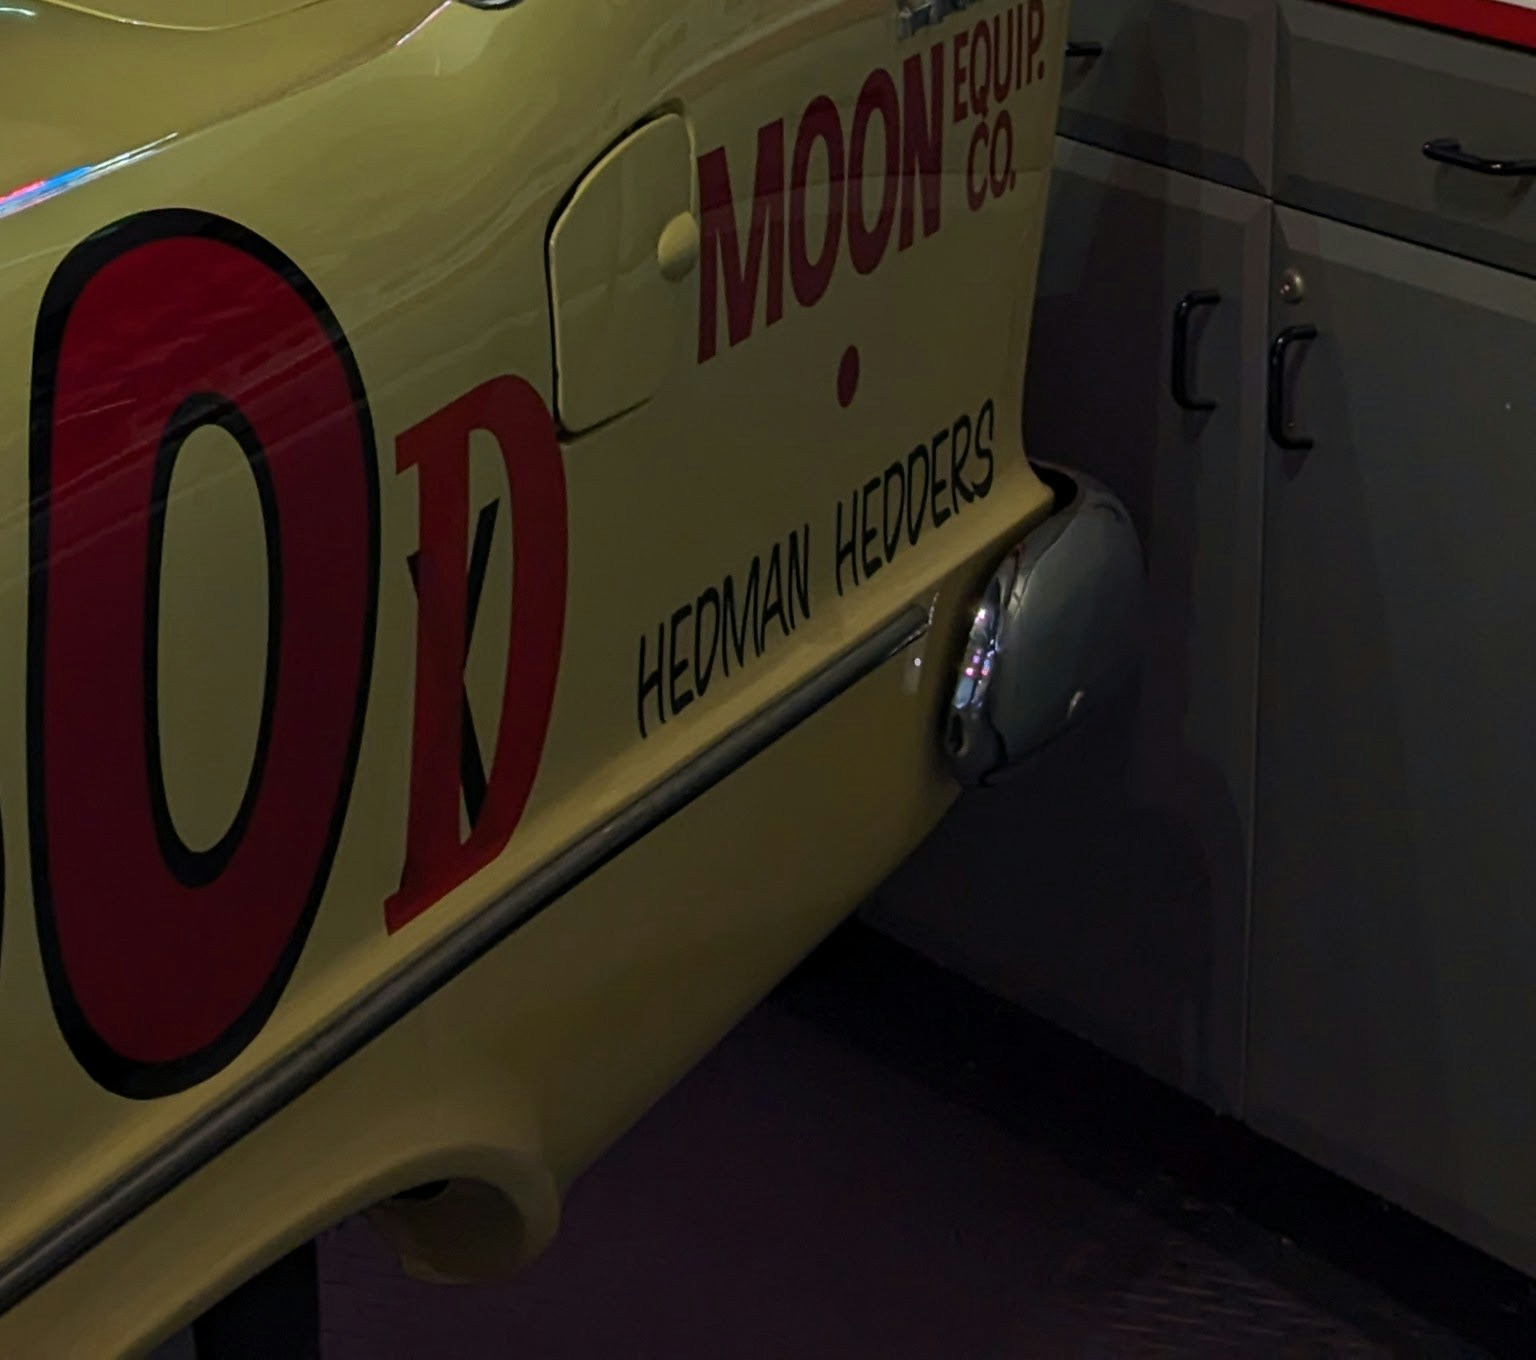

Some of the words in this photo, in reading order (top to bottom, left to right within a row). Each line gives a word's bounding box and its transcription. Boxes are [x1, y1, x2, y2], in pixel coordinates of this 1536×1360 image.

[697, 41, 945, 366] MOON
[966, 108, 1017, 212] CO.
[637, 523, 811, 739] HEDMAN
[835, 398, 995, 597] HEDDERS
